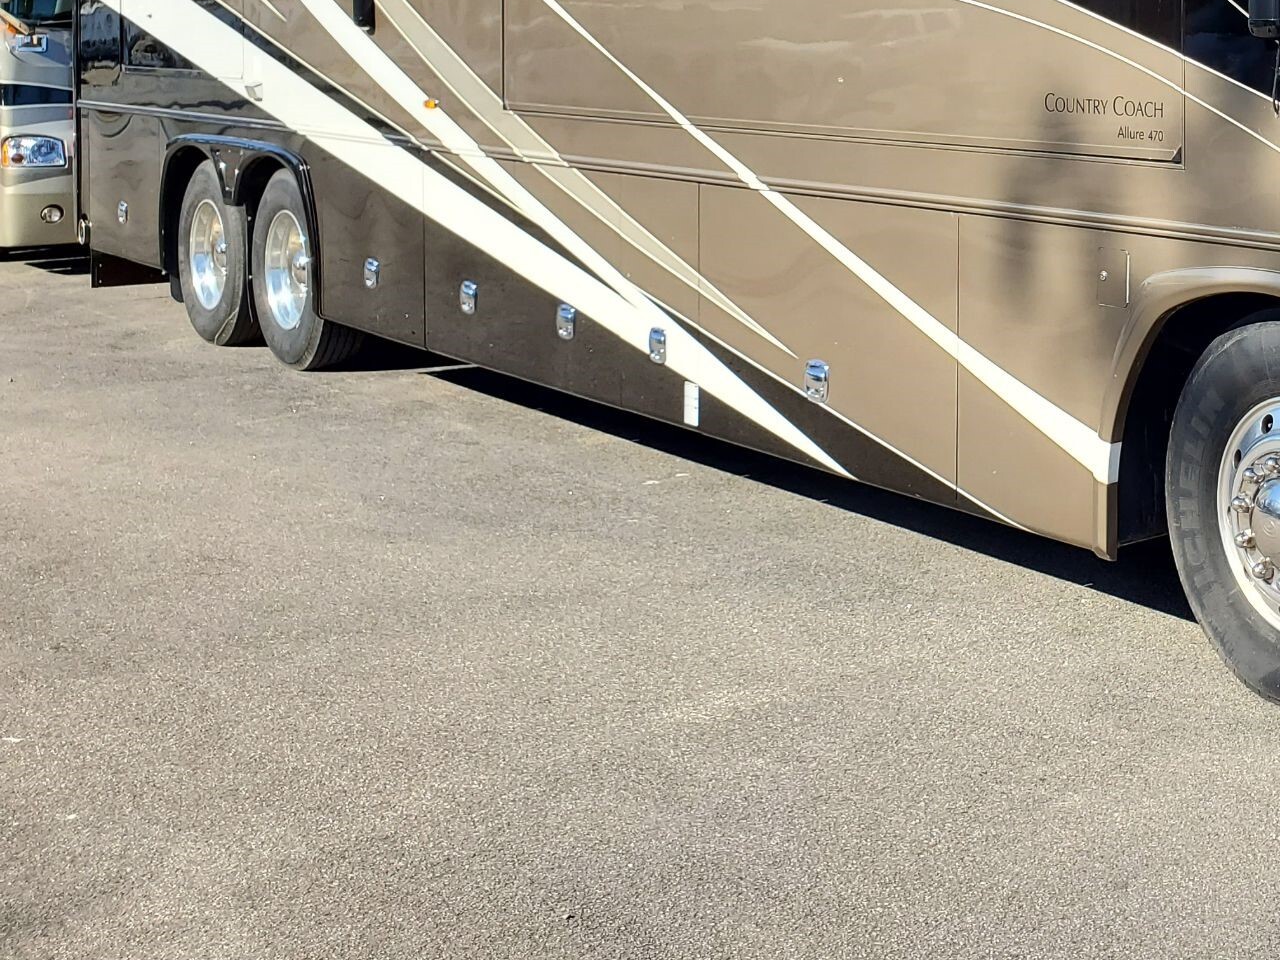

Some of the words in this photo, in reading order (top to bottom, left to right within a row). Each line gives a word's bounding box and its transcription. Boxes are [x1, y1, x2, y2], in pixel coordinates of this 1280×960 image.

[1044, 92, 1109, 115] COUNTRY
[1112, 95, 1164, 119] COACH
[1117, 126, 1145, 141] Allure
[1148, 130, 1164, 142] 470
